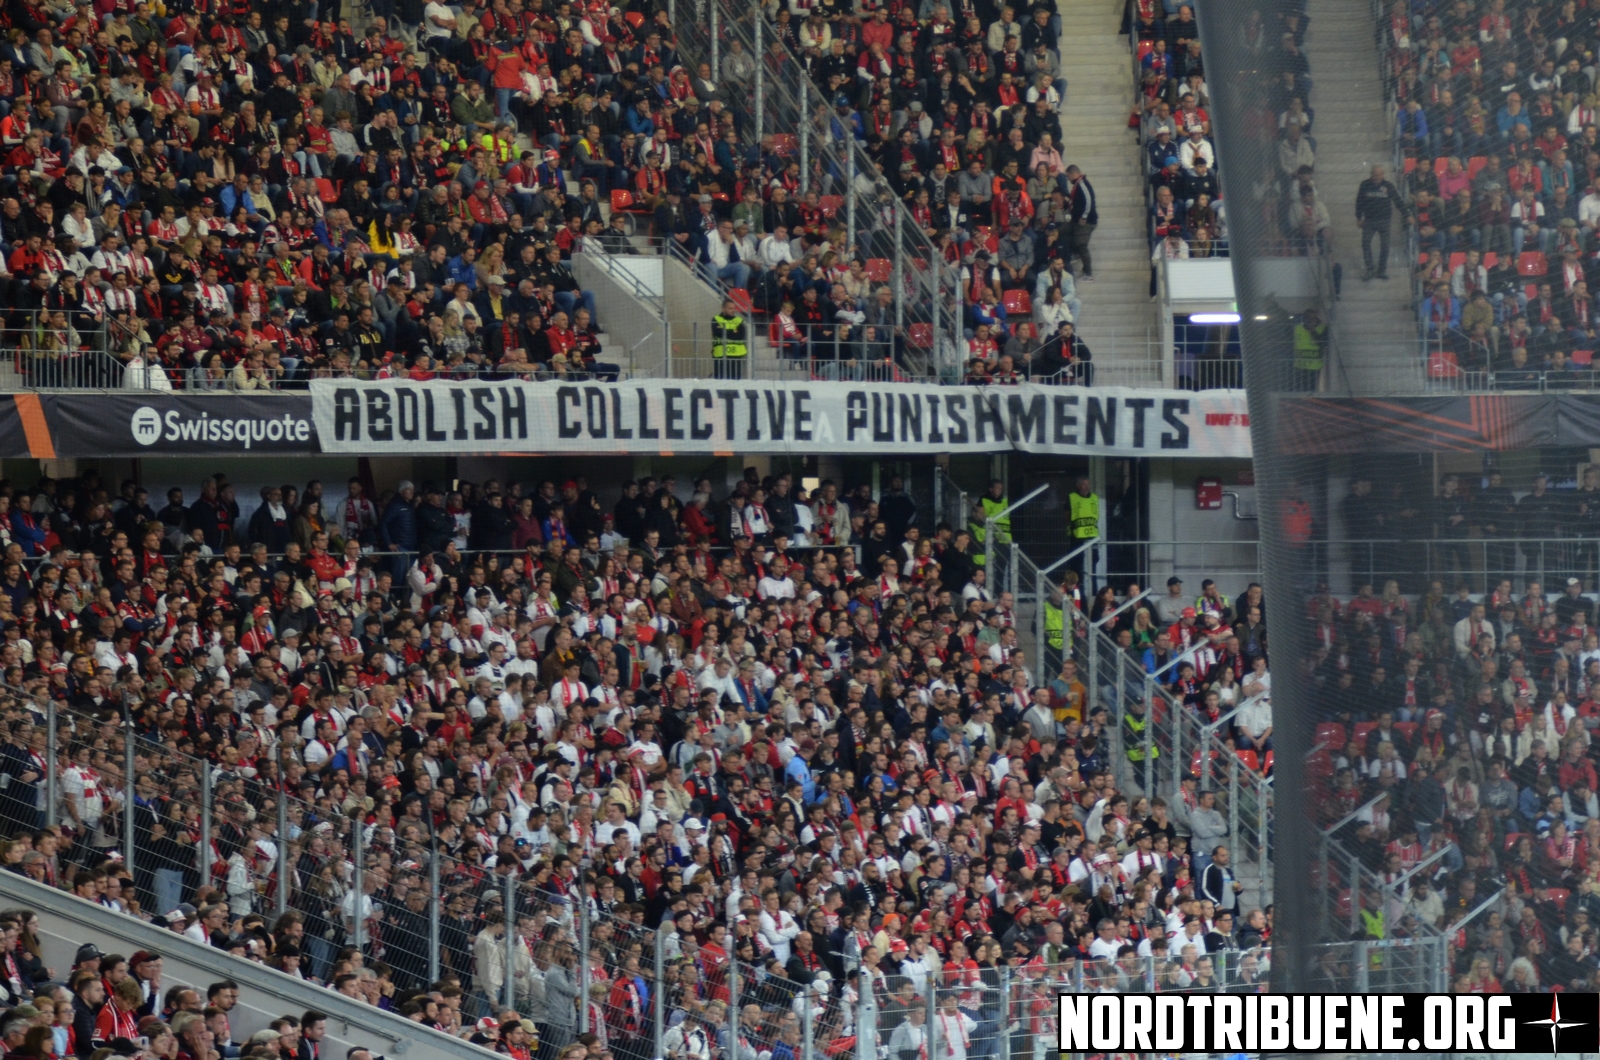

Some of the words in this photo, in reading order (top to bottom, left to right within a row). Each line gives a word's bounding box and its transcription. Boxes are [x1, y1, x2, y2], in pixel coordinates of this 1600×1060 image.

[164, 409, 310, 449] Swissquote
[333, 387, 528, 441] ABOLISH
[556, 386, 812, 440] COLLECTIVE
[847, 391, 1190, 449] PUNISHMENTS
